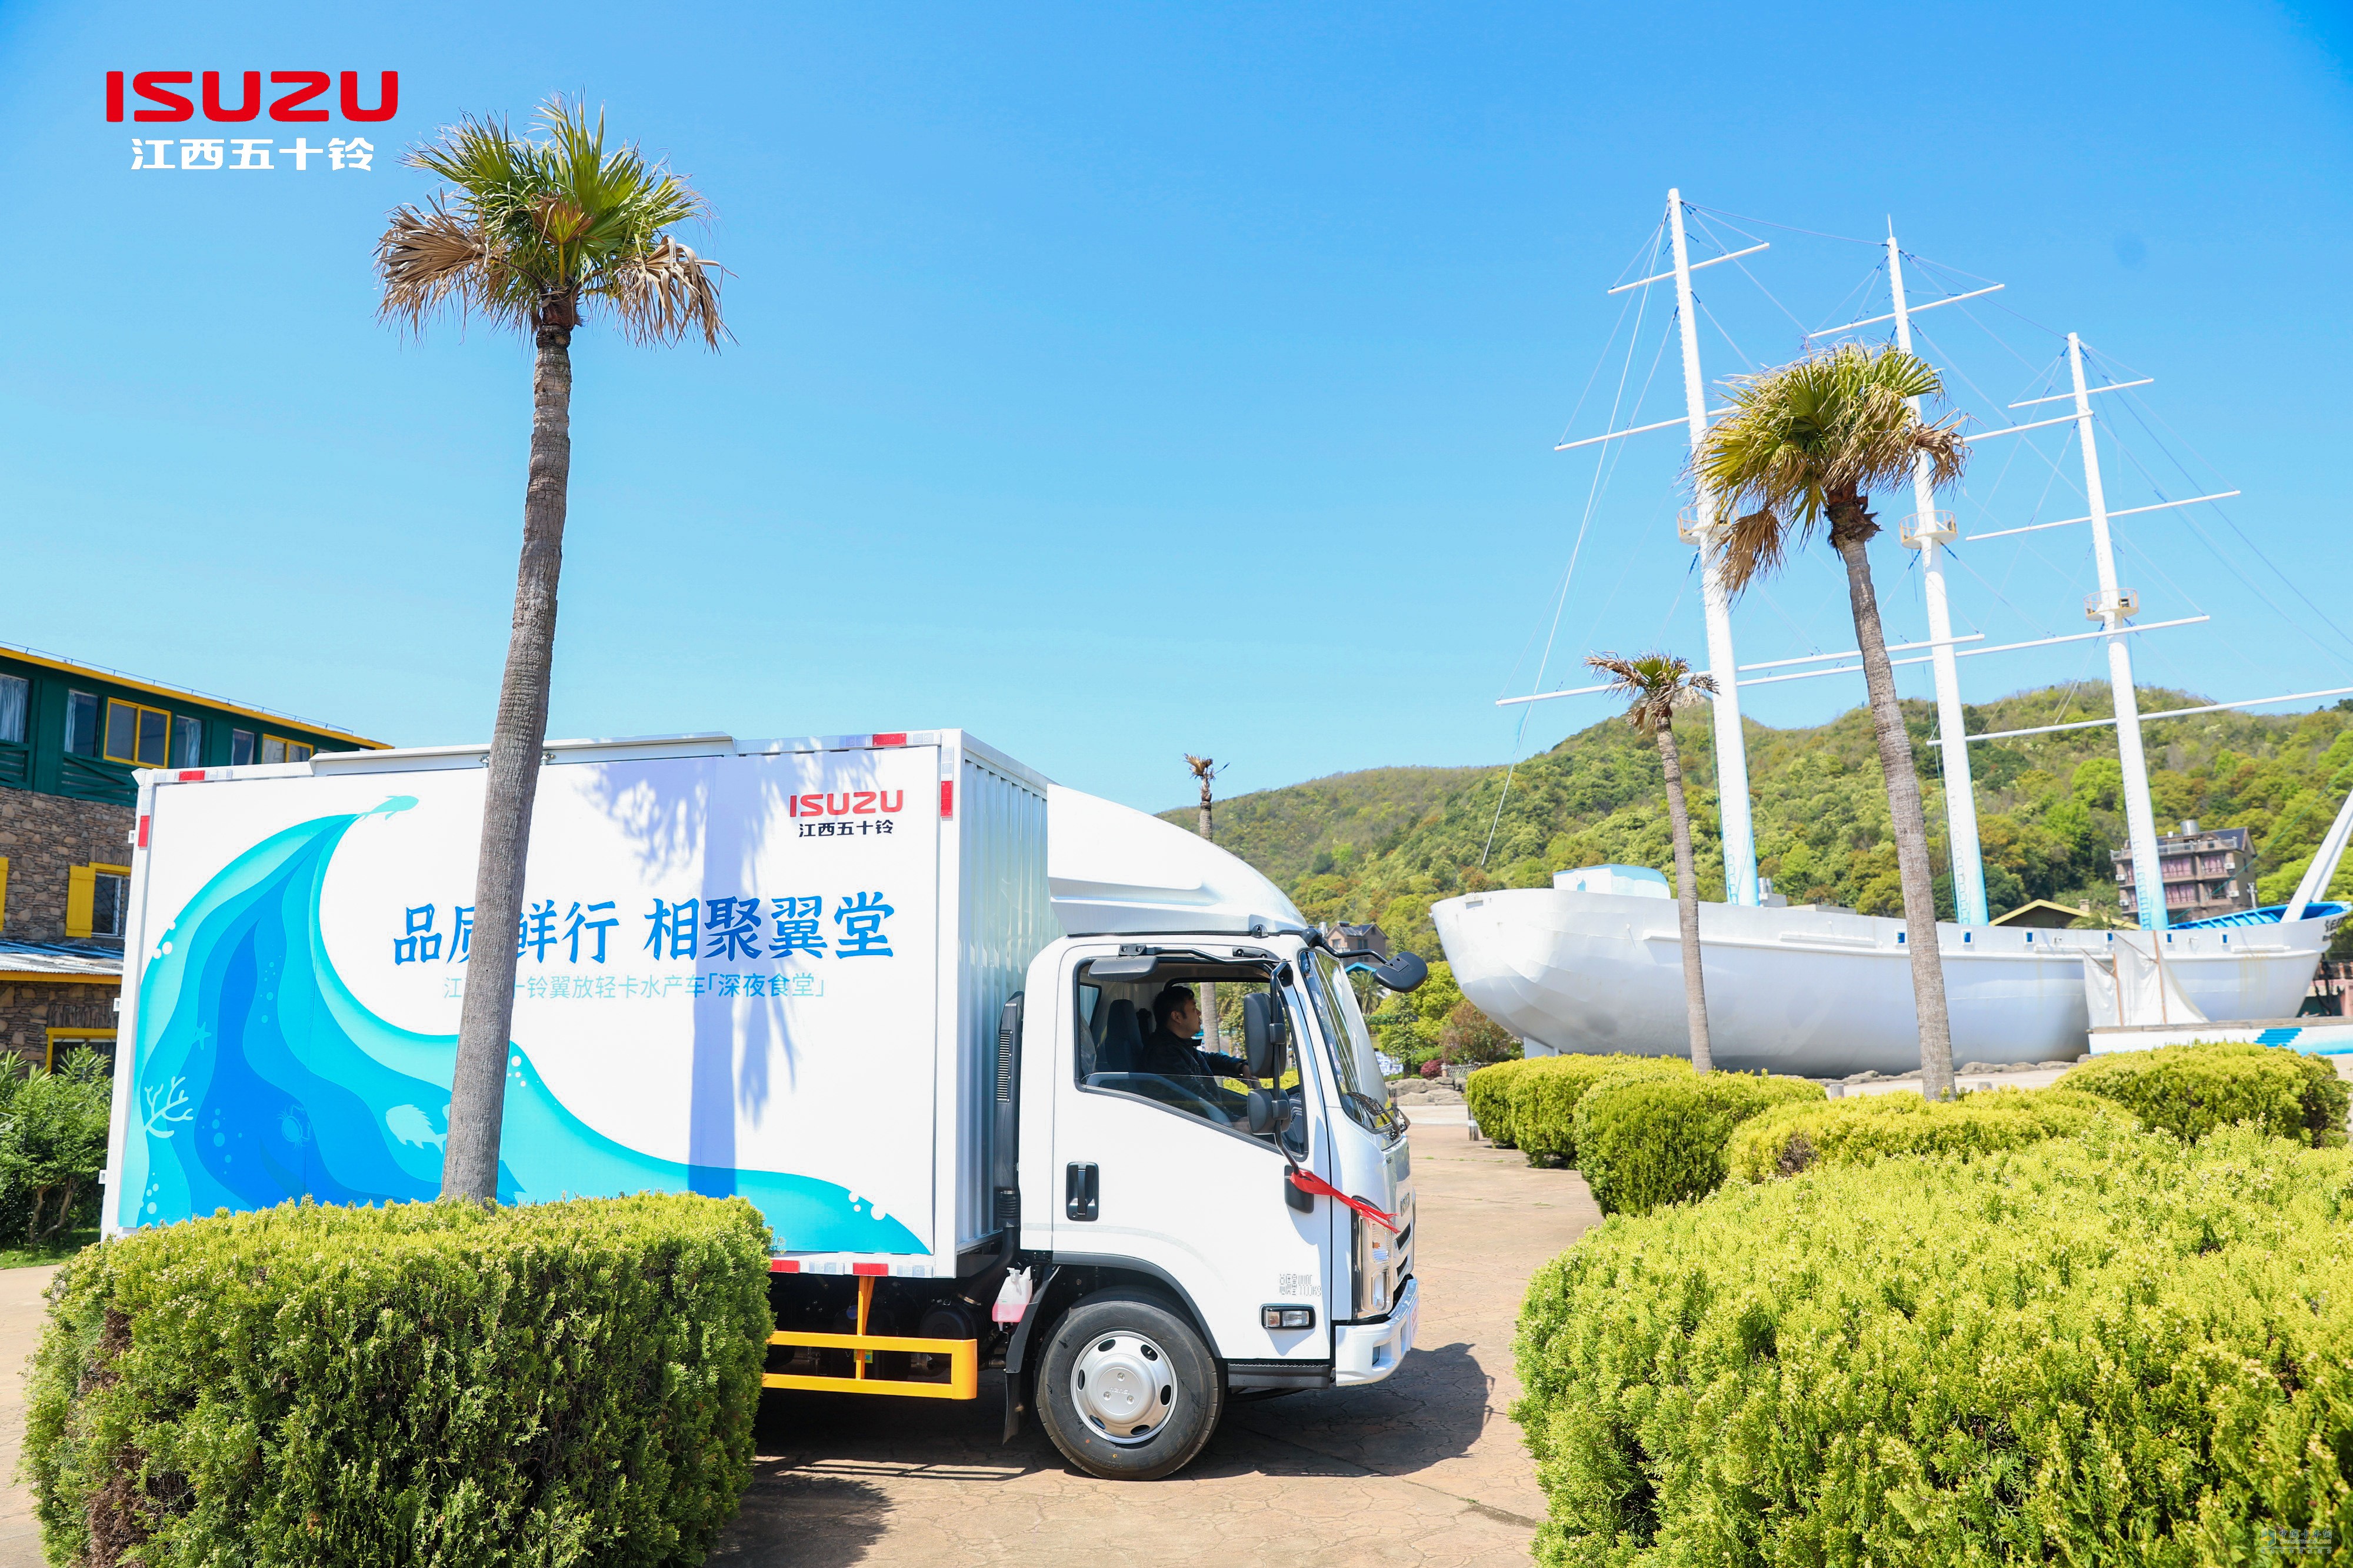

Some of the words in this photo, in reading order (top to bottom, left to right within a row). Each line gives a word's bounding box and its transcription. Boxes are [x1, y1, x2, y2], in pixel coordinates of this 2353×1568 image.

[790, 790, 903, 817] ISUZU
[799, 819, 893, 837] 江西五十铃
[643, 891, 895, 962] 相聚翼堂
[444, 972, 825, 999] 江铃翼放轻卡水产车「深夜食堂」
